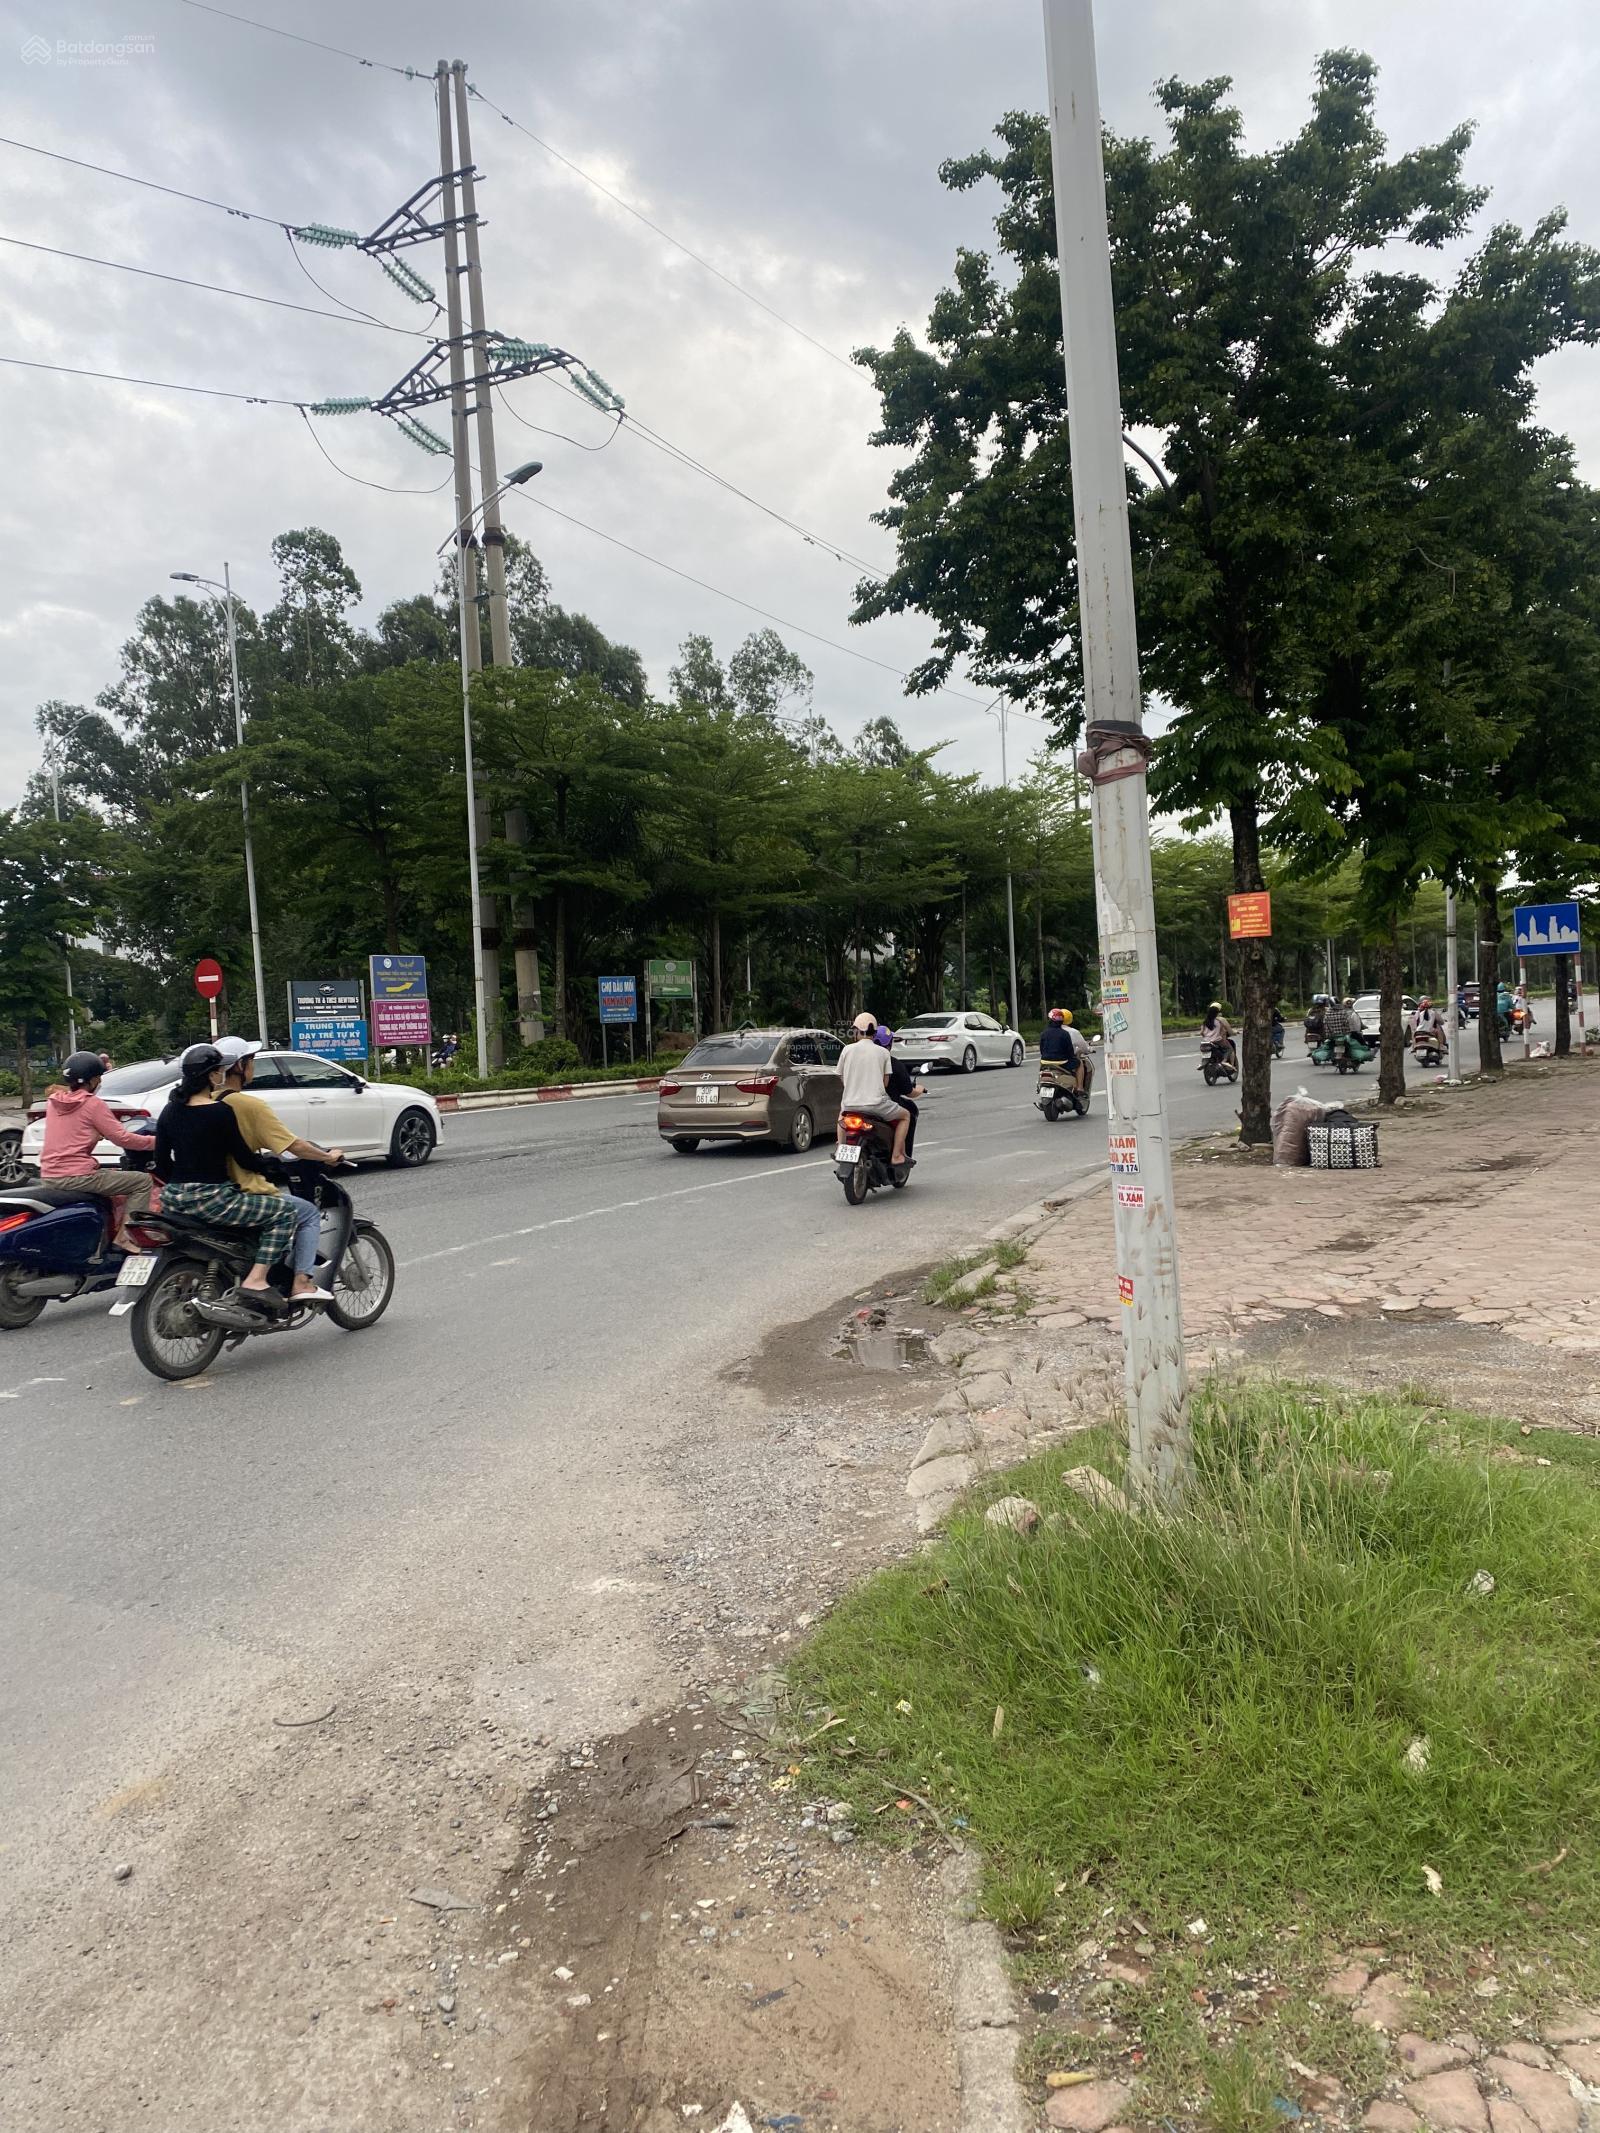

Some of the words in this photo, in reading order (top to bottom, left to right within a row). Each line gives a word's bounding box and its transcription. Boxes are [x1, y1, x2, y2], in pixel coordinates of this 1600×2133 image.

[305, 1022, 334, 1030] TRUNG
[336, 1021, 354, 1029] TÂM
[1121, 1152, 1136, 1163] XE
[1126, 1164, 1138, 1172] 174
